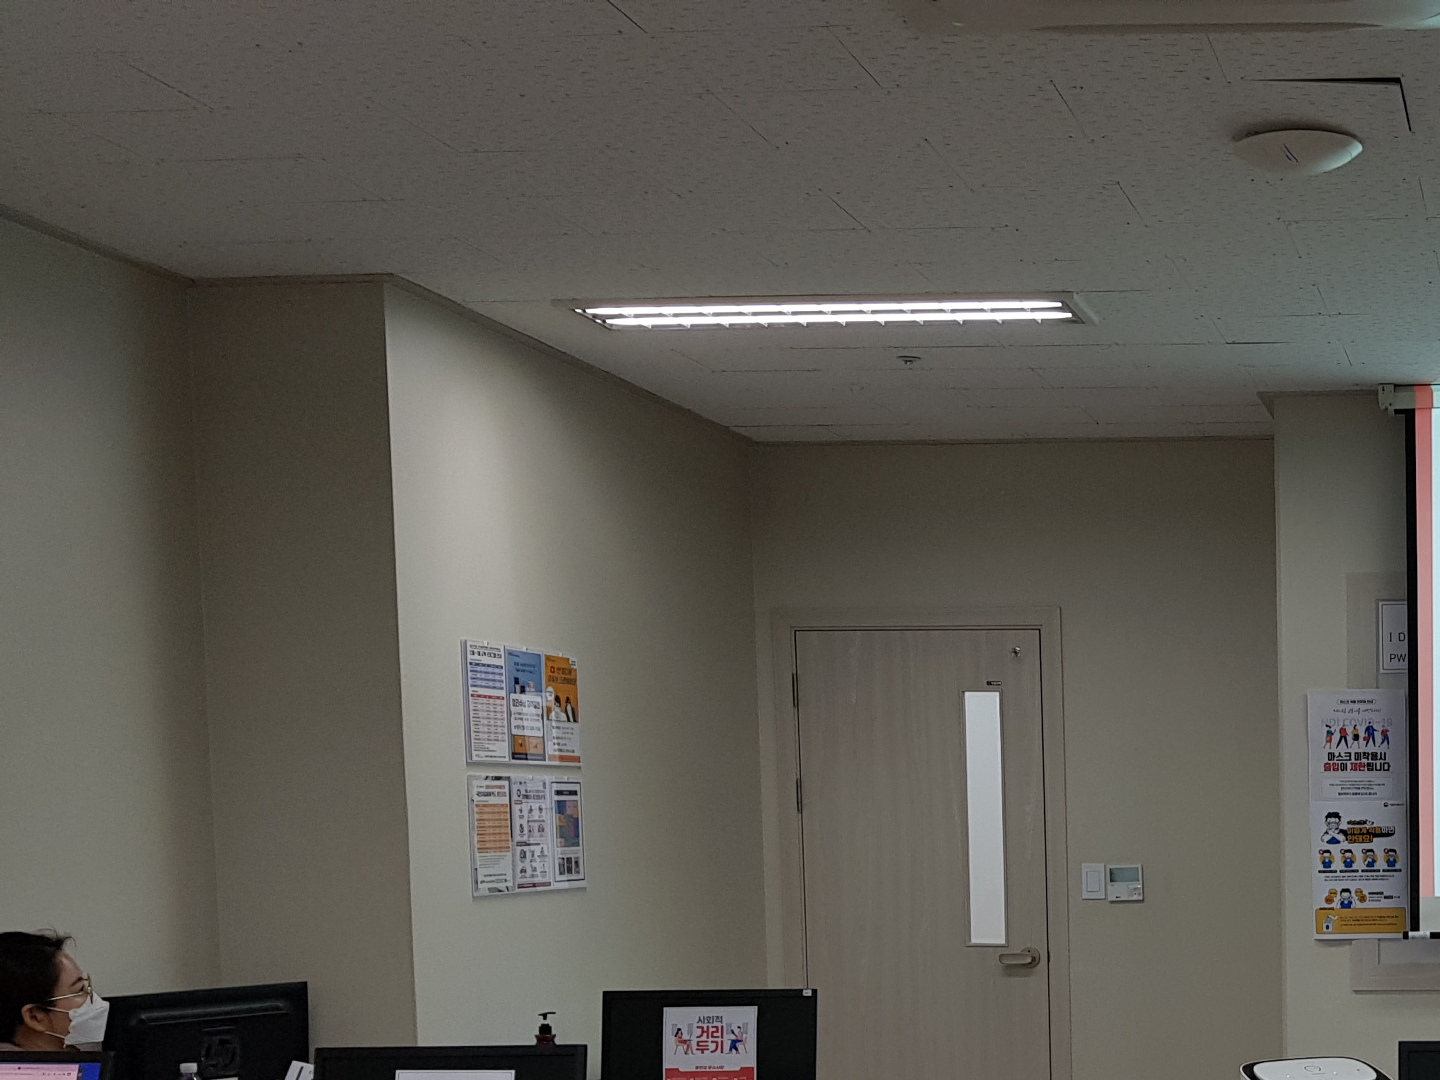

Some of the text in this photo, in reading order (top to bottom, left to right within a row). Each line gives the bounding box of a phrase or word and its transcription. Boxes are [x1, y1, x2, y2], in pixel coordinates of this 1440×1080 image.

[1328, 752, 1387, 761] 마스크 미착용시
[696, 1015, 723, 1024] 사회적
[696, 1025, 724, 1039] 거리
[695, 1040, 725, 1054] 두기
